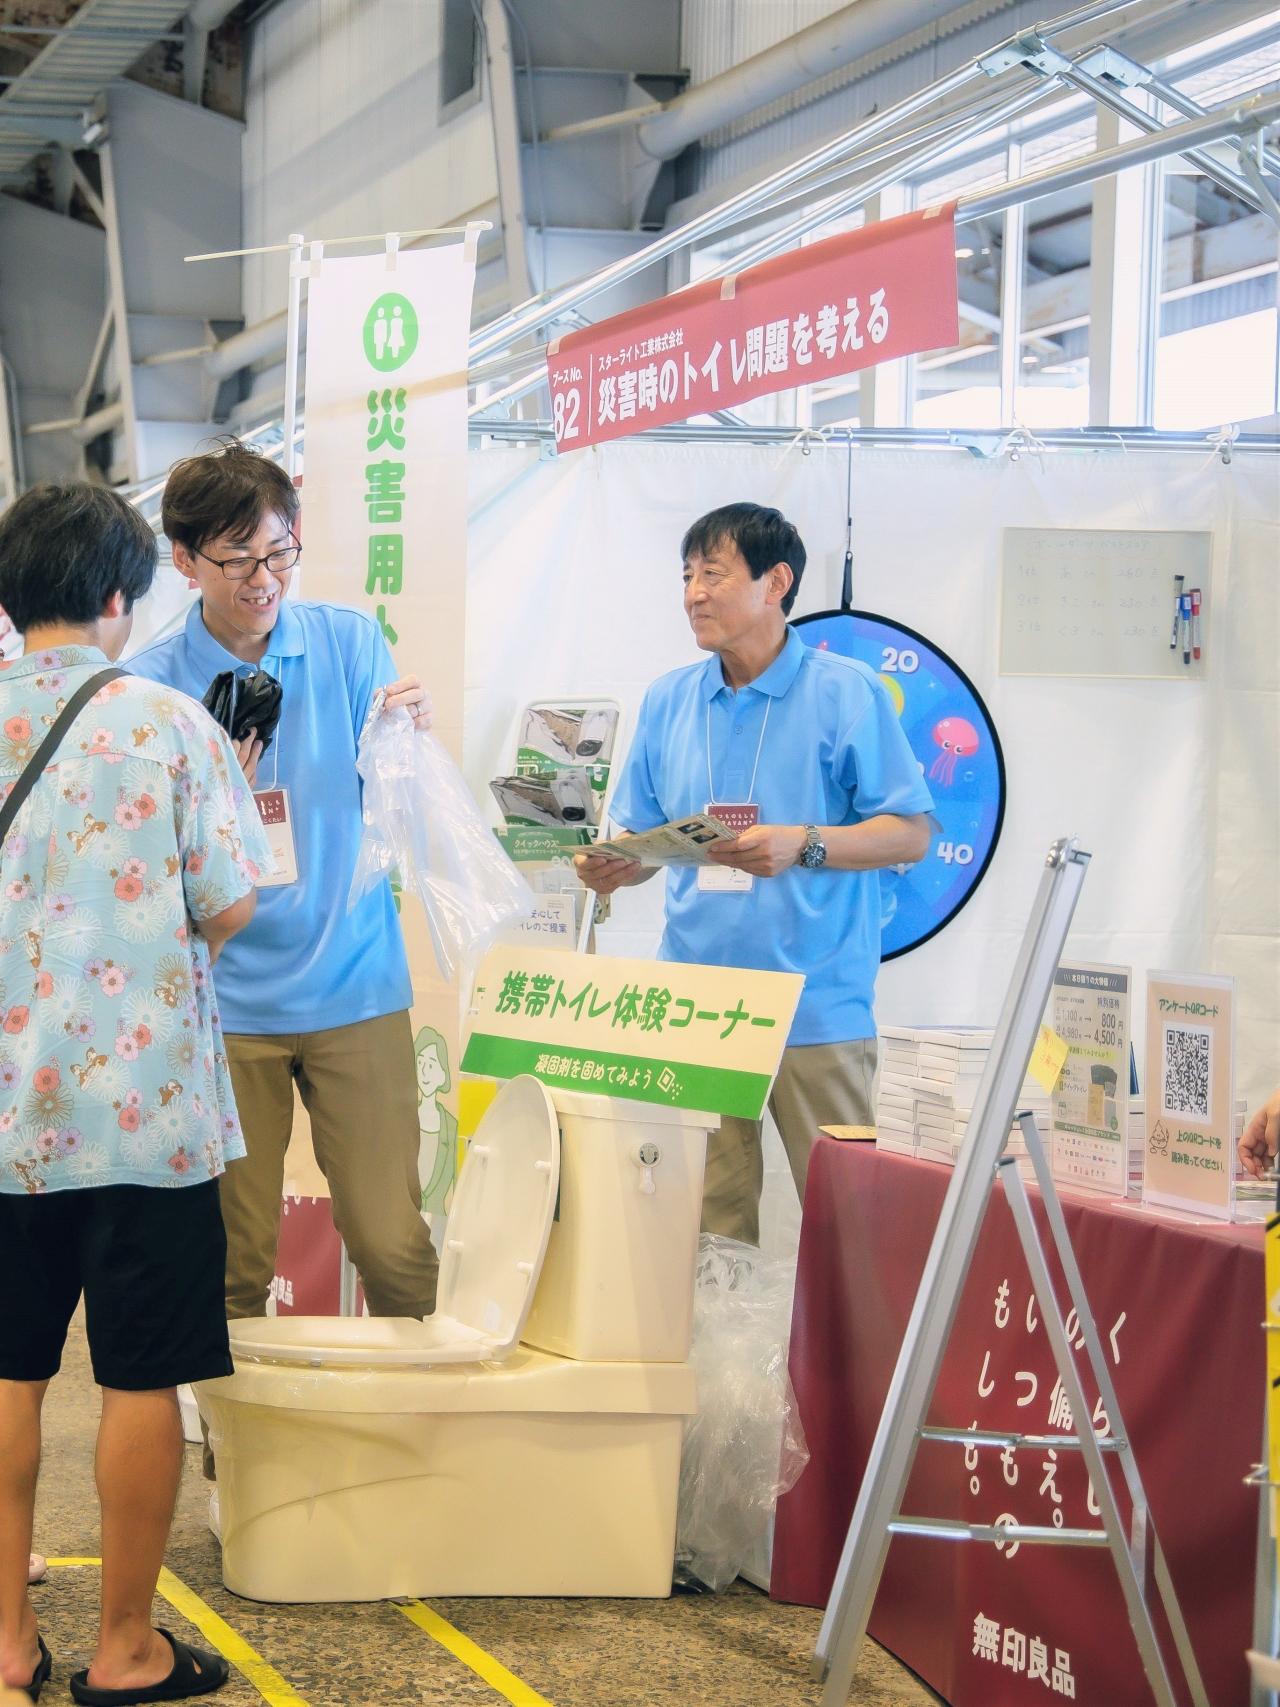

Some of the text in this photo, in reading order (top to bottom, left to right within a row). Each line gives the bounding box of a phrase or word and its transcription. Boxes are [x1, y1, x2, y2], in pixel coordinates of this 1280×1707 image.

[597, 288, 889, 426] 災害時のトイレ問題を考える
[598, 328, 684, 373] スターライト工業株式会社
[553, 388, 581, 443] 82
[881, 646, 919, 673] 20
[937, 841, 975, 865] 40
[518, 922, 569, 933] イレのご提案
[495, 969, 776, 1040] 携帯トイレ体験コーナー
[1158, 998, 1219, 1018] アンケートQRコード
[534, 1053, 652, 1090] 凝固剤を固めてみよう
[1176, 1129, 1222, 1150] 上のQRコードを
[972, 1611, 1075, 1699] 無印良品
